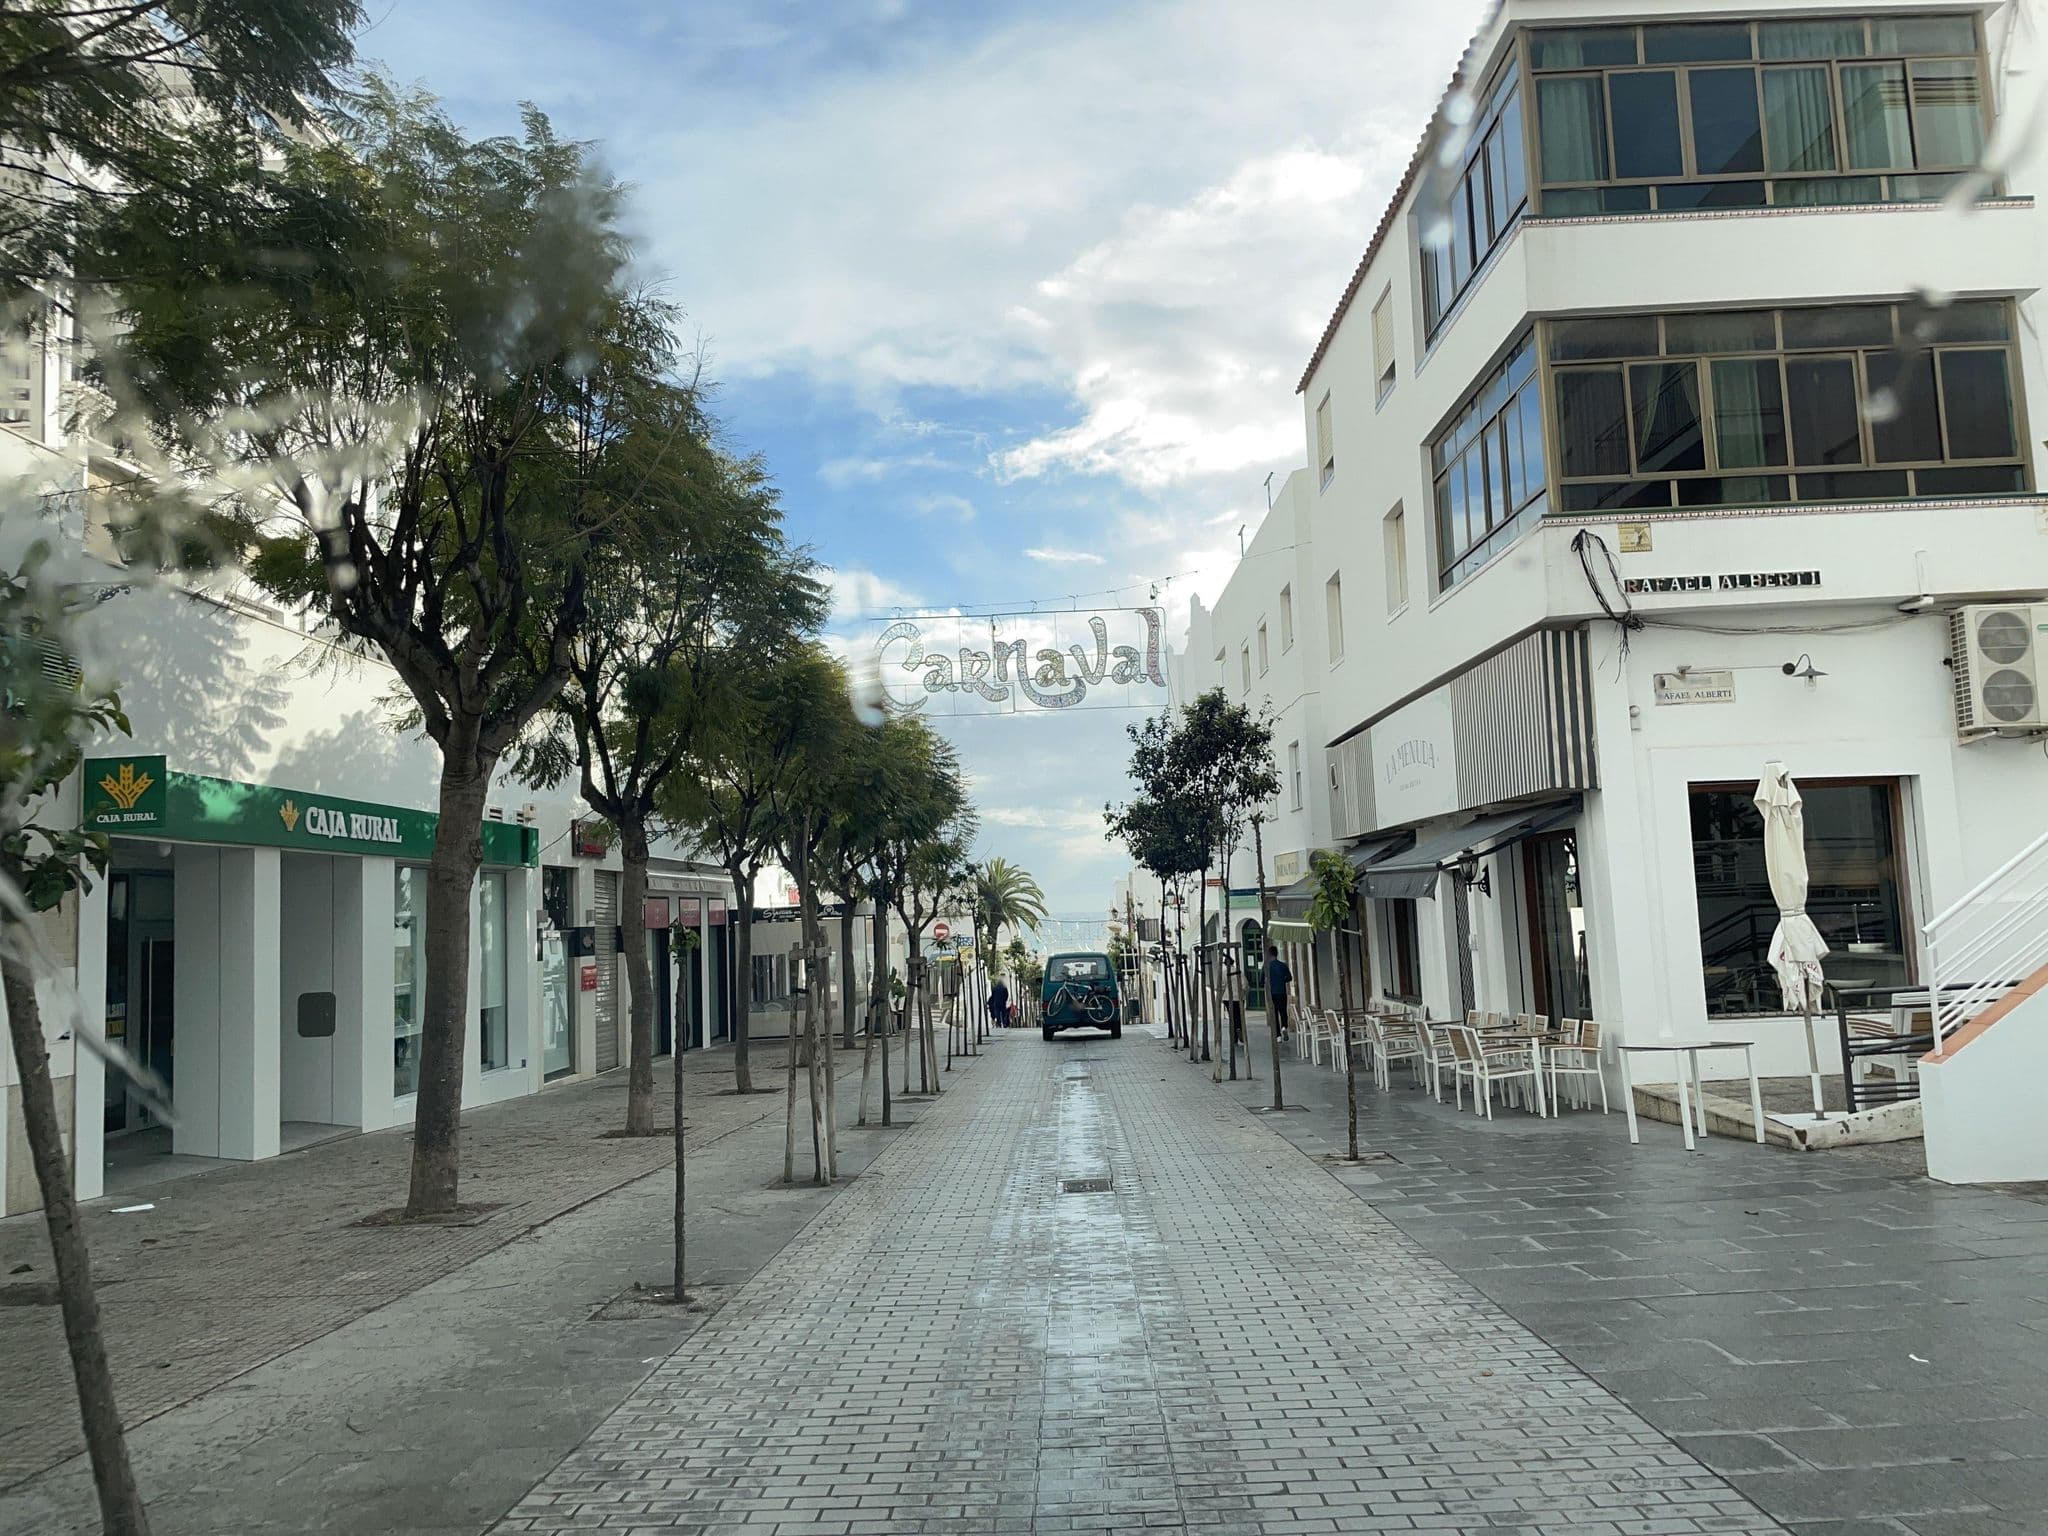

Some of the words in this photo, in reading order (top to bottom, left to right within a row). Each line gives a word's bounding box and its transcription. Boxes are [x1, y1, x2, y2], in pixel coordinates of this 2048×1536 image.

[1626, 576, 1711, 593] RAFAEL
[1719, 571, 1821, 589] ALBERTI
[1658, 692, 1690, 700] AFAEL
[1694, 690, 1732, 698] ALBERTI
[97, 814, 121, 824] CAJA
[123, 812, 158, 822] RURAL
[305, 806, 349, 839] CAJA
[350, 812, 402, 844] RURAL
